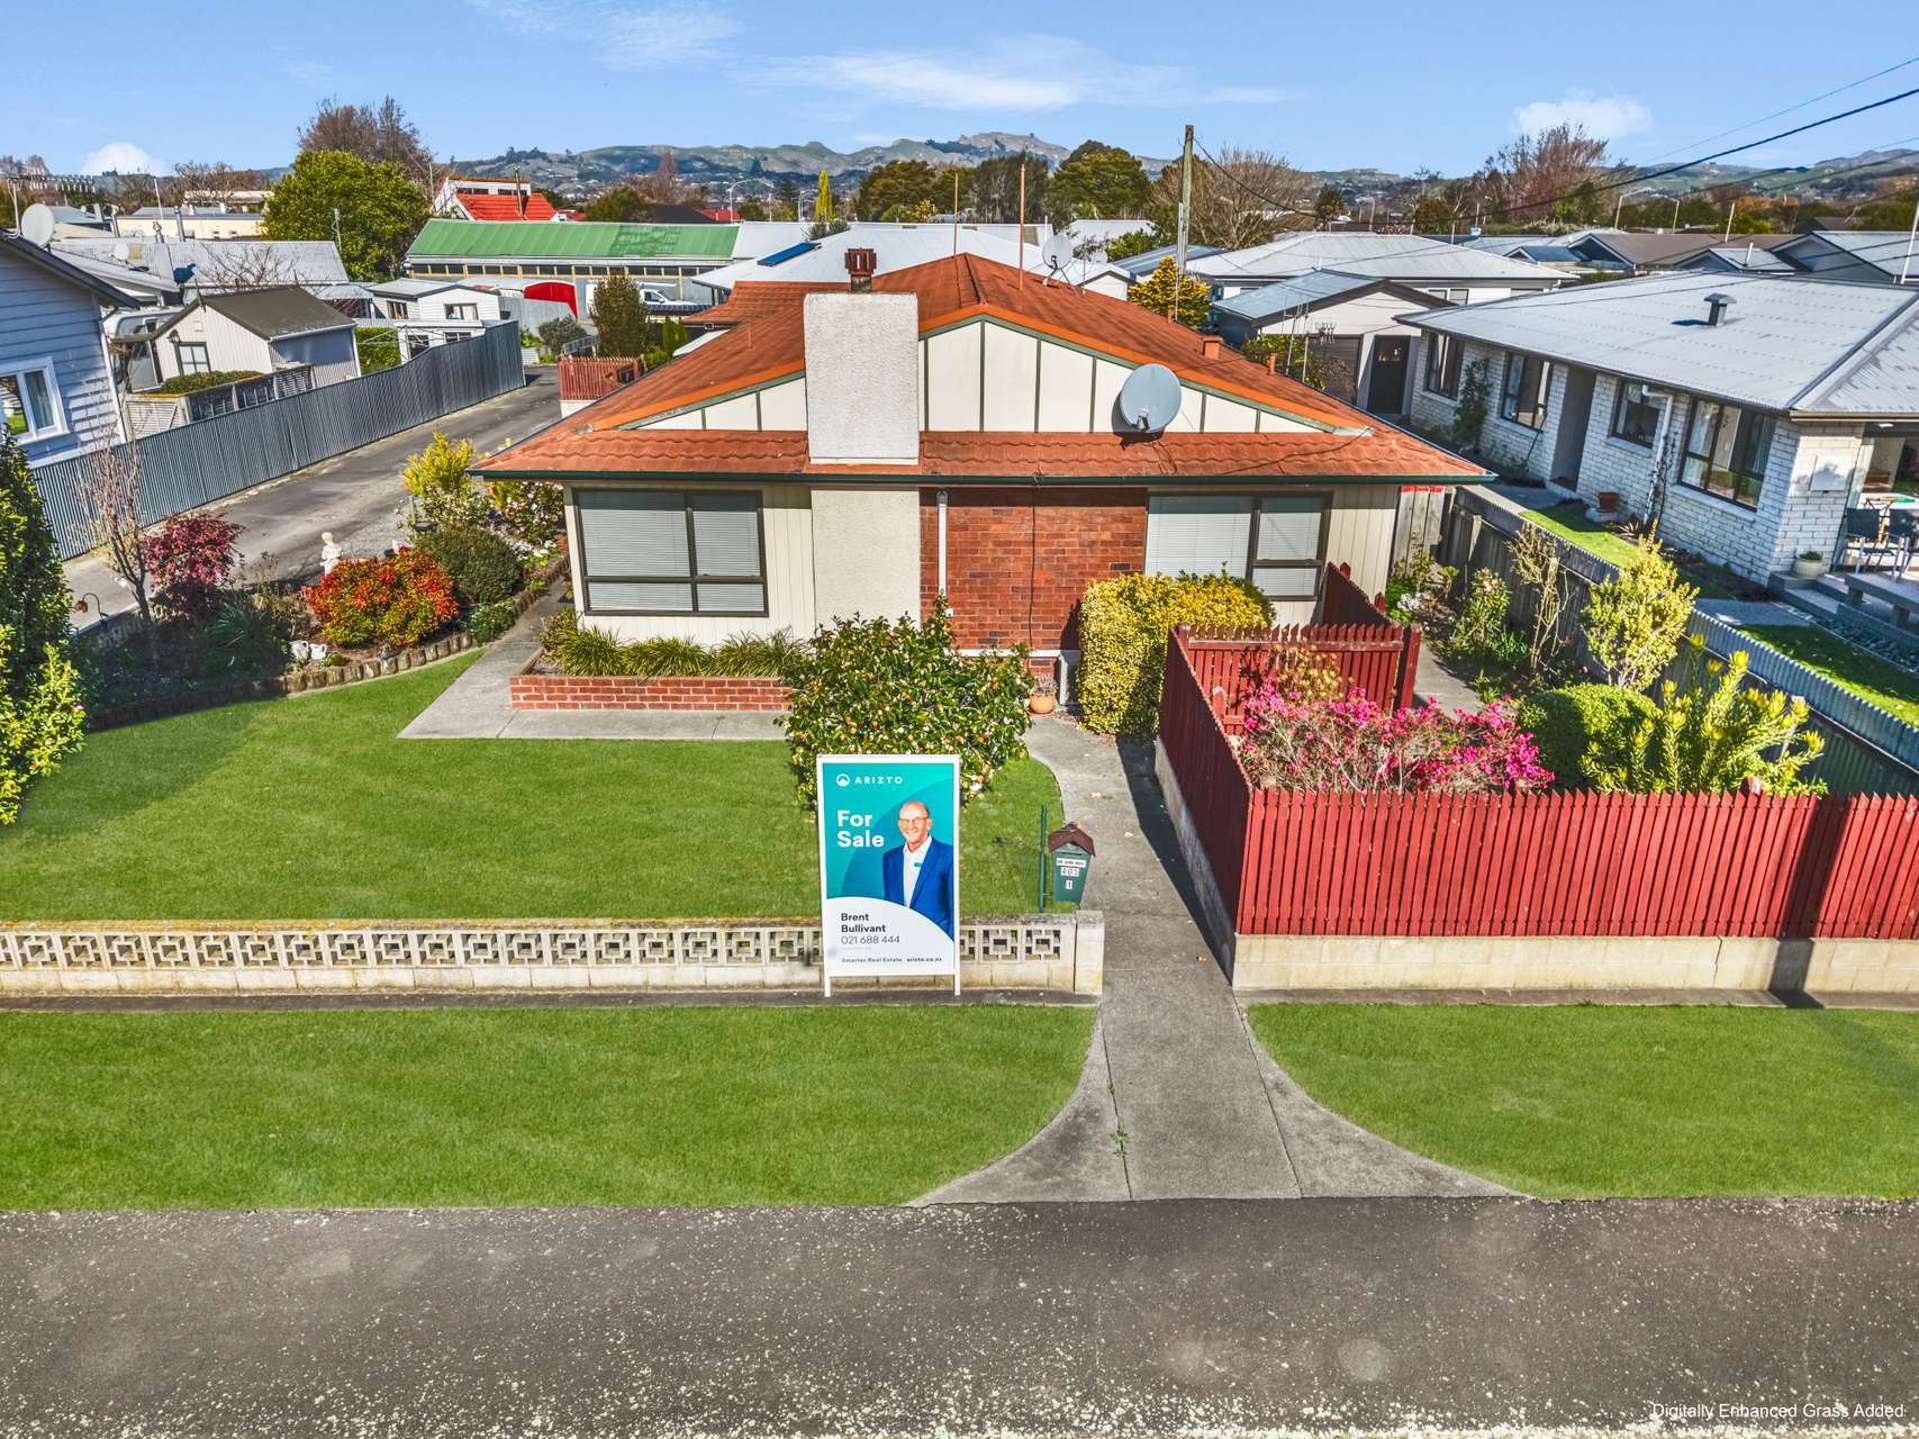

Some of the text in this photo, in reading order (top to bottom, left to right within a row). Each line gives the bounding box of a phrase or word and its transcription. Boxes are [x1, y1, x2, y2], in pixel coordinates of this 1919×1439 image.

[855, 776, 903, 785] ARIZTO
[837, 810, 873, 827] For
[837, 830, 885, 848] Sale
[841, 913, 869, 922] Brent
[841, 924, 886, 933] Bullivant
[841, 935, 900, 944] 021 688 444
